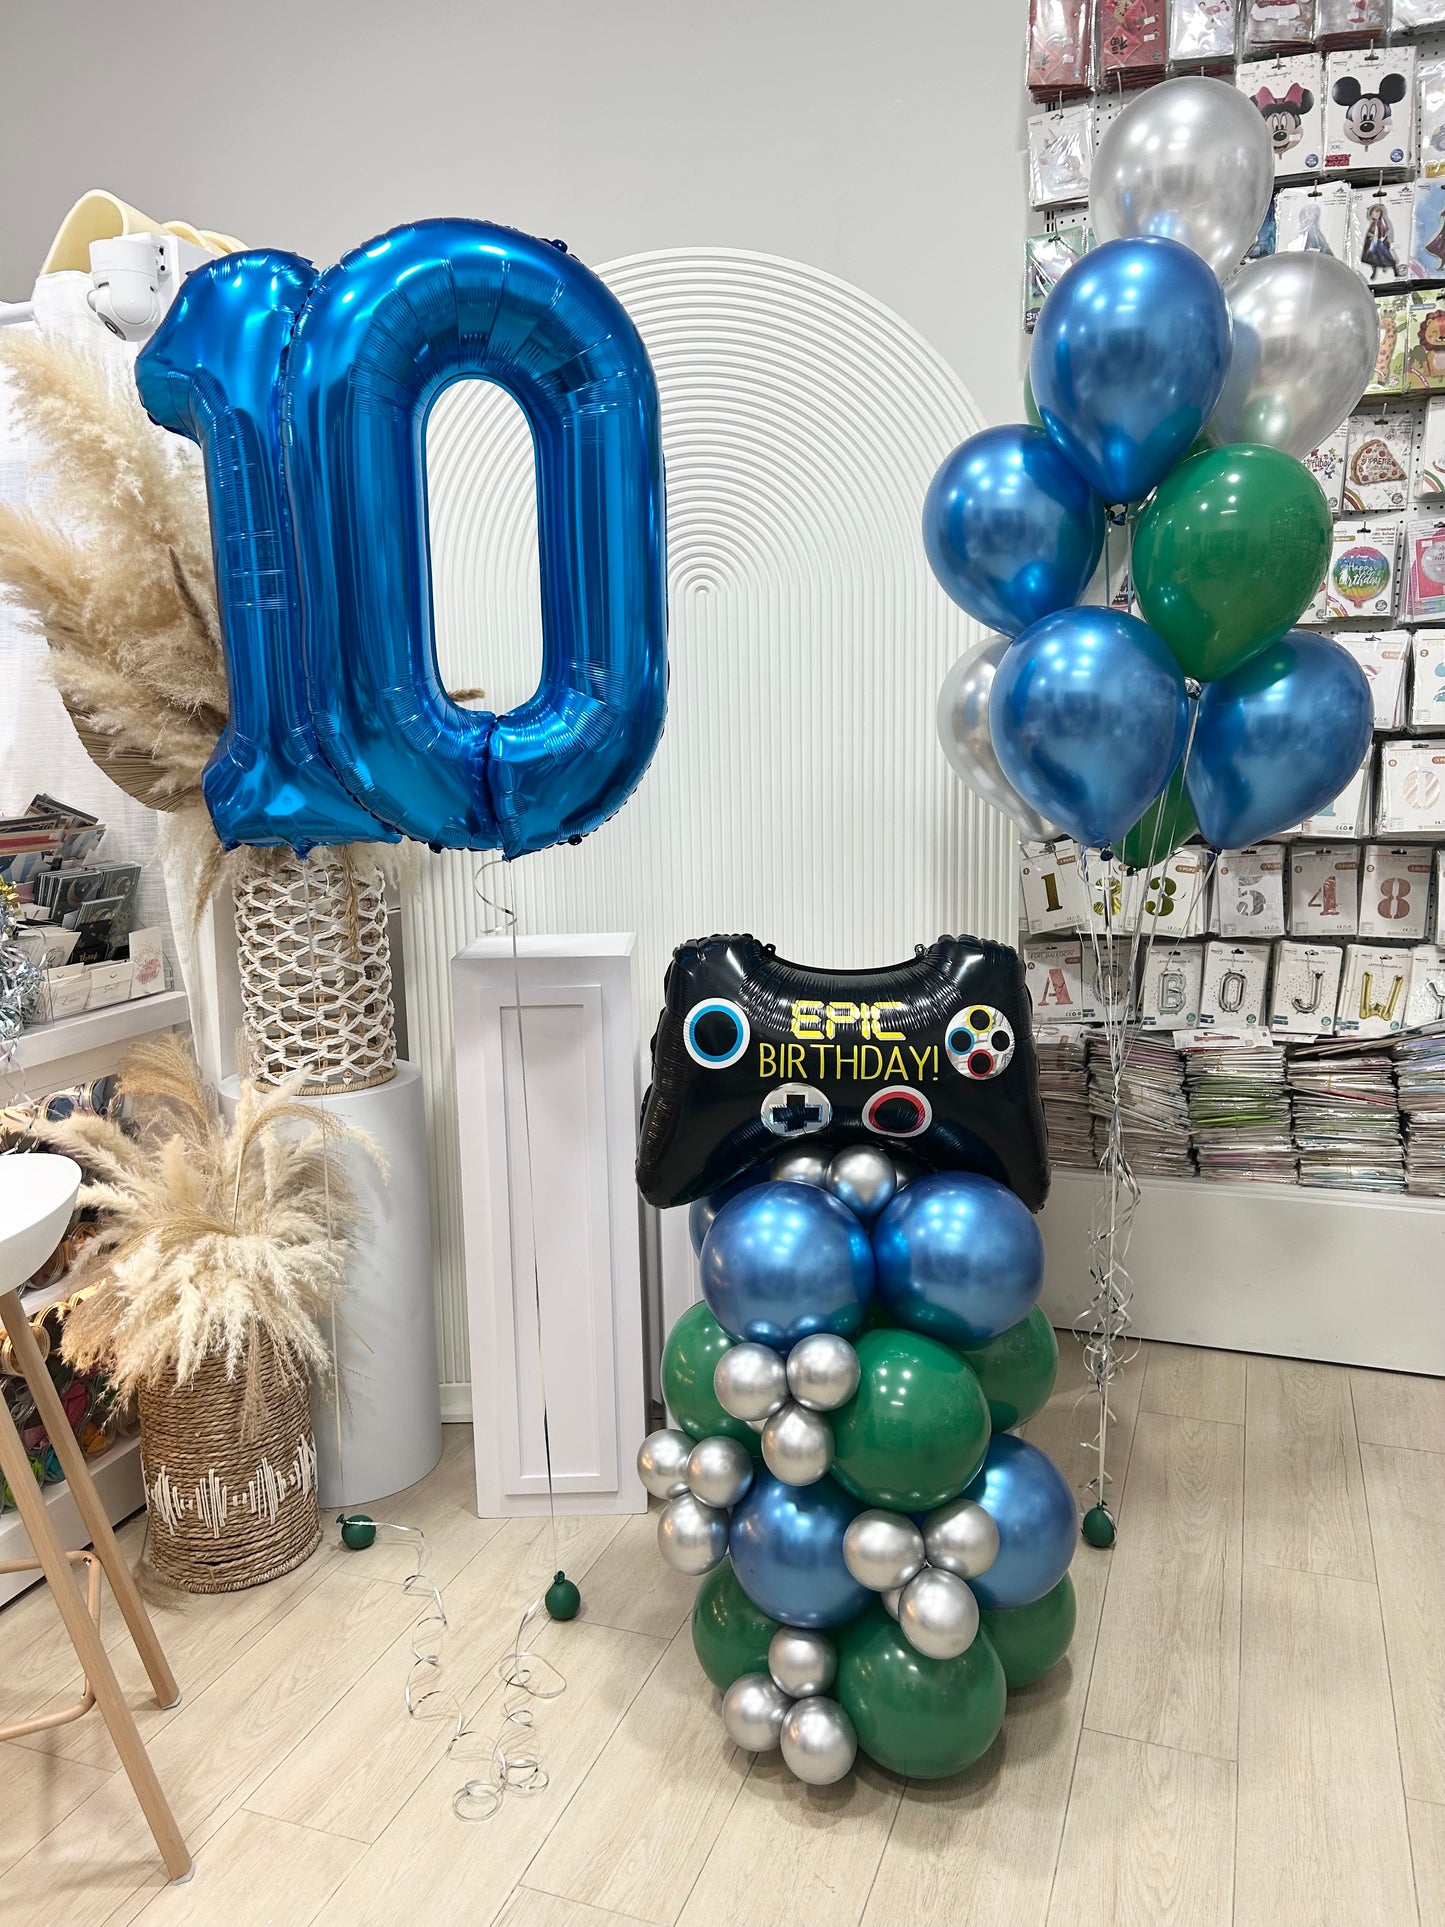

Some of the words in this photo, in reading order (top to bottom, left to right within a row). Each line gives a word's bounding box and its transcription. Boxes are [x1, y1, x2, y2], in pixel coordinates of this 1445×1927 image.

[1348, 562, 1374, 575] Happy
[1041, 873, 1063, 912] 1
[1144, 876, 1177, 916] 3
[1236, 875, 1266, 916] 5
[1308, 876, 1339, 916] 4
[1377, 877, 1411, 919] 8
[1037, 968, 1073, 1006] A
[1157, 968, 1186, 1015] B
[1291, 970, 1325, 1014] J
[1359, 972, 1404, 1021] W
[791, 1000, 906, 1041] EPIC
[759, 1043, 940, 1081] BIRTHDAY!
